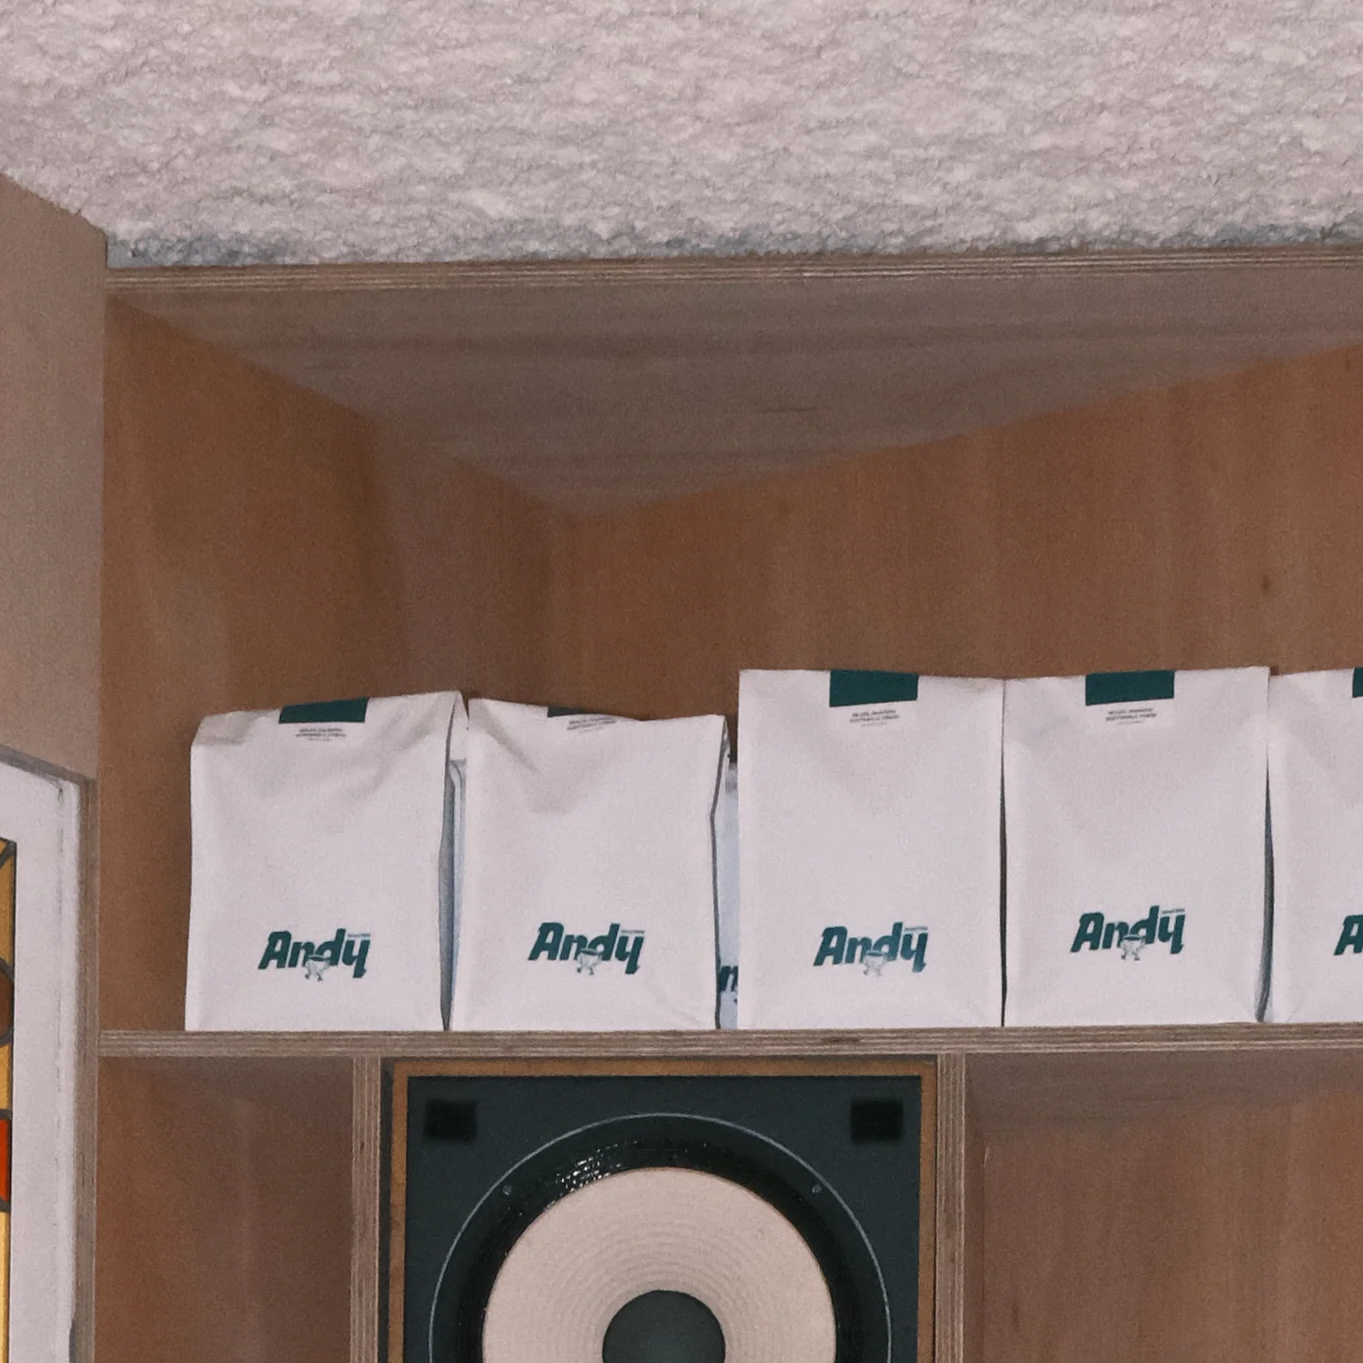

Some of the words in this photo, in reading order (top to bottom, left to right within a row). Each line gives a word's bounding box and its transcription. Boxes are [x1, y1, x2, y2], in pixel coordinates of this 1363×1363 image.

[257, 928, 371, 979] Andy
[528, 921, 645, 975] Andy
[813, 922, 928, 974] Andy
[1070, 904, 1186, 955] Andy
